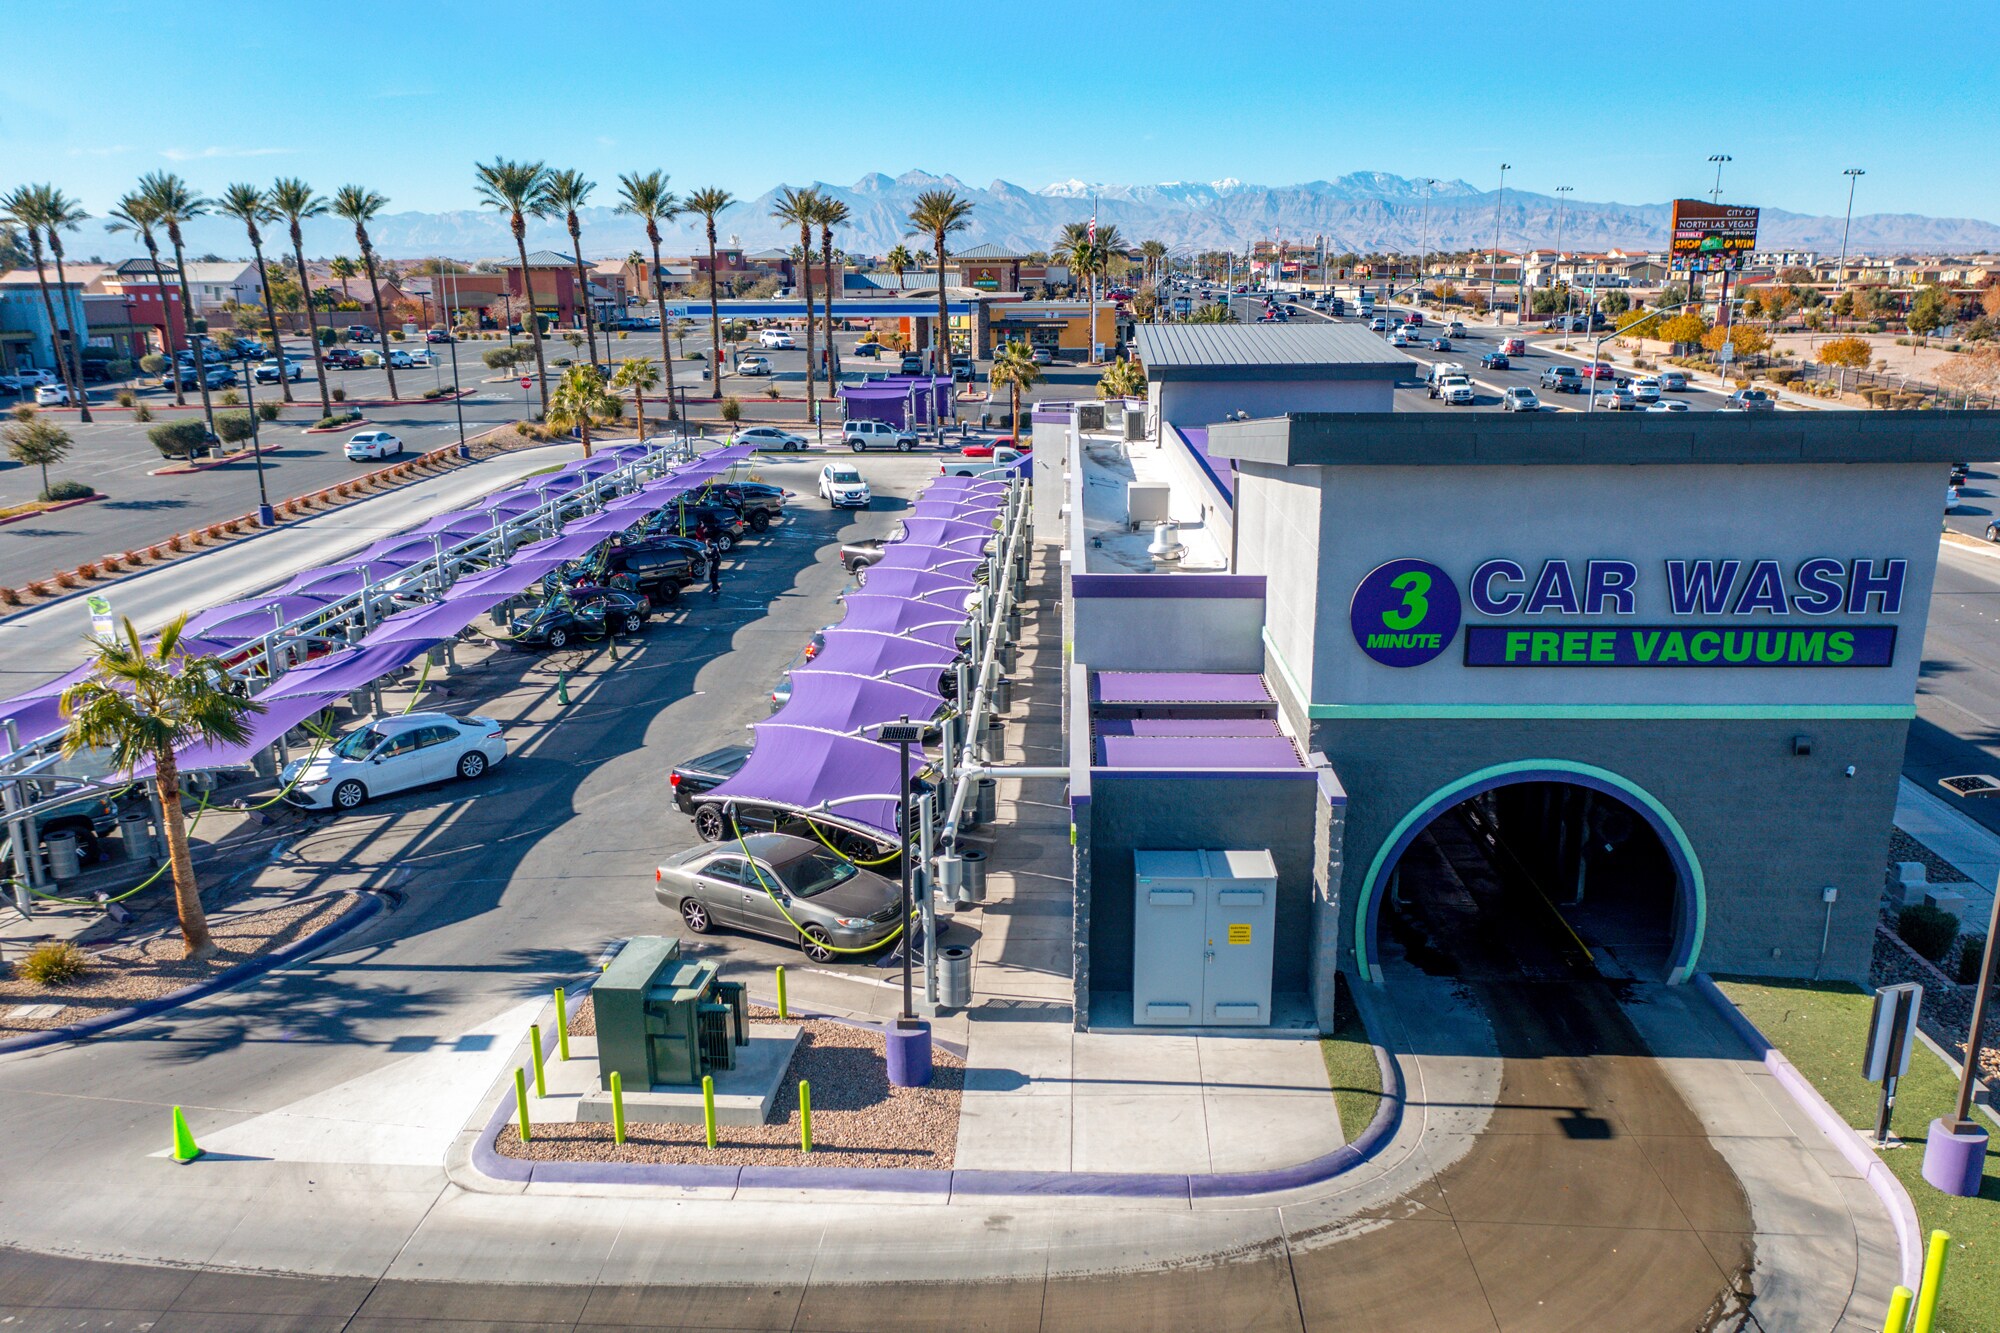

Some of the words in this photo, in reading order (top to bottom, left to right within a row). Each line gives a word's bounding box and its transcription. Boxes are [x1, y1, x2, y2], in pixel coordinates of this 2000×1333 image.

[1679, 220, 1708, 228] NORTH
[1710, 220, 1725, 228] LAS
[1728, 220, 1754, 228] VEGAS
[1674, 240, 1700, 249] SHOP
[1724, 240, 1733, 248] &
[1735, 239, 1754, 248] WIN
[1470, 558, 1638, 616] CAR
[1666, 558, 1908, 616] WASH
[1382, 571, 1432, 630] 3
[1366, 634, 1442, 648] MINUTE
[1505, 631, 1616, 662] FREE
[1632, 631, 1854, 662] VACUUMS
